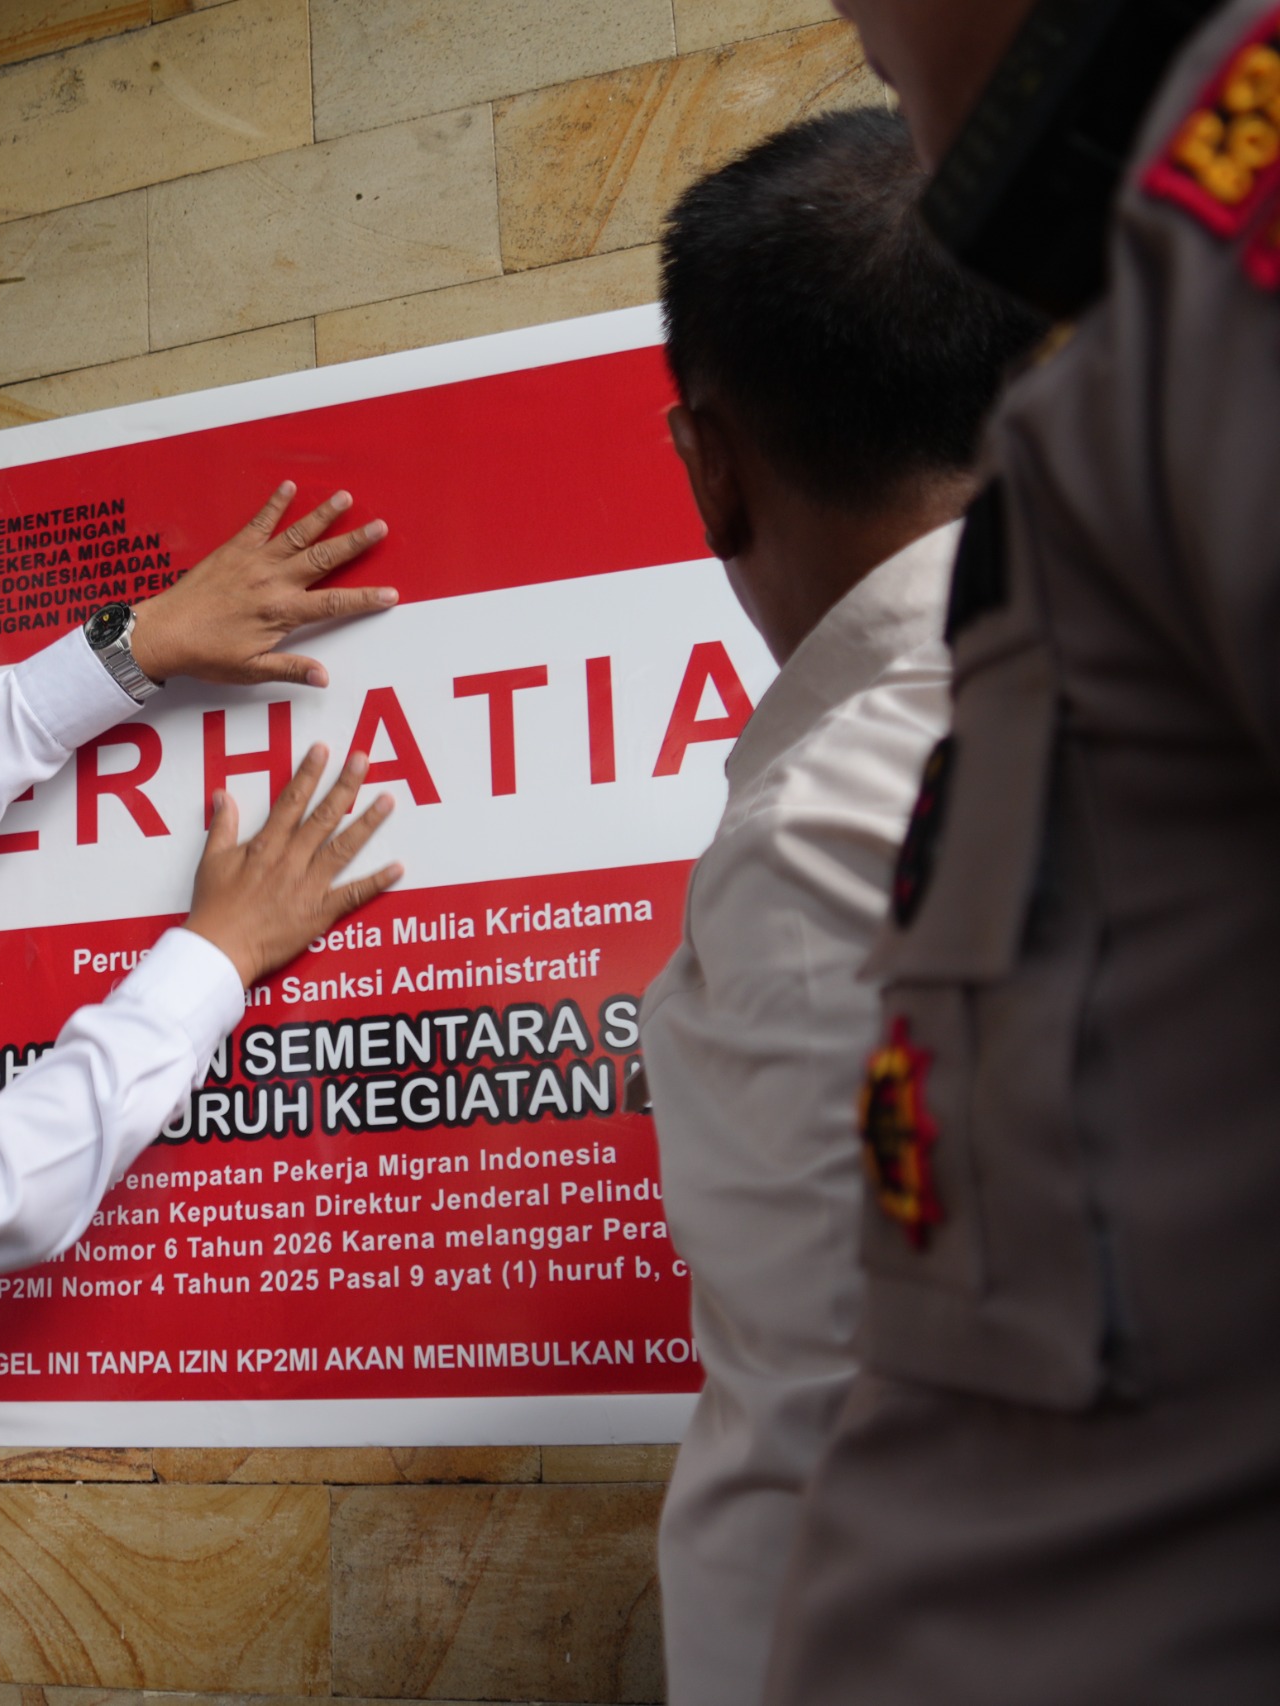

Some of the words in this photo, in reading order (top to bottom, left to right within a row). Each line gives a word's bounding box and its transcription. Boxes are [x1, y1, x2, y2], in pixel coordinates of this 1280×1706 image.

[78, 533, 160, 561] MIGRAN
[393, 913, 475, 945] Mulia
[486, 899, 652, 934] Kridatama
[282, 969, 383, 1004] Sanksi
[393, 949, 601, 994] Administratif
[245, 1005, 586, 1076] SEMENTARA
[326, 1063, 610, 1129] KEGIATAN
[274, 1156, 369, 1184] Pekerja
[379, 1150, 469, 1180] Migran
[480, 1142, 616, 1171] Indonesia
[170, 1196, 305, 1227] Keputusan
[315, 1189, 422, 1217] Direktur
[431, 1181, 550, 1212] Jenderal
[75, 1241, 156, 1262] Nomor
[164, 1237, 178, 1259] 6
[187, 1236, 263, 1258] Tahun
[273, 1232, 332, 1256] 2026
[342, 1229, 435, 1253] Karena
[445, 1222, 592, 1251] melanggar
[61, 1274, 143, 1299] Nomor
[151, 1274, 164, 1296] 4
[173, 1272, 250, 1295] Tahun
[260, 1268, 319, 1293] 2025
[329, 1265, 399, 1290] Pasal
[410, 1265, 424, 1287] 9
[434, 1263, 491, 1291] ayat
[501, 1260, 537, 1289] (1)
[548, 1257, 624, 1283] huruf
[635, 1257, 660, 1282] b,
[48, 1351, 79, 1375] INI
[86, 1350, 171, 1374] TANPA
[179, 1349, 227, 1373] IZIN
[236, 1347, 318, 1372] KP2MI
[325, 1345, 404, 1371] AKAN
[413, 1340, 634, 1369] MENIMBULKAN
